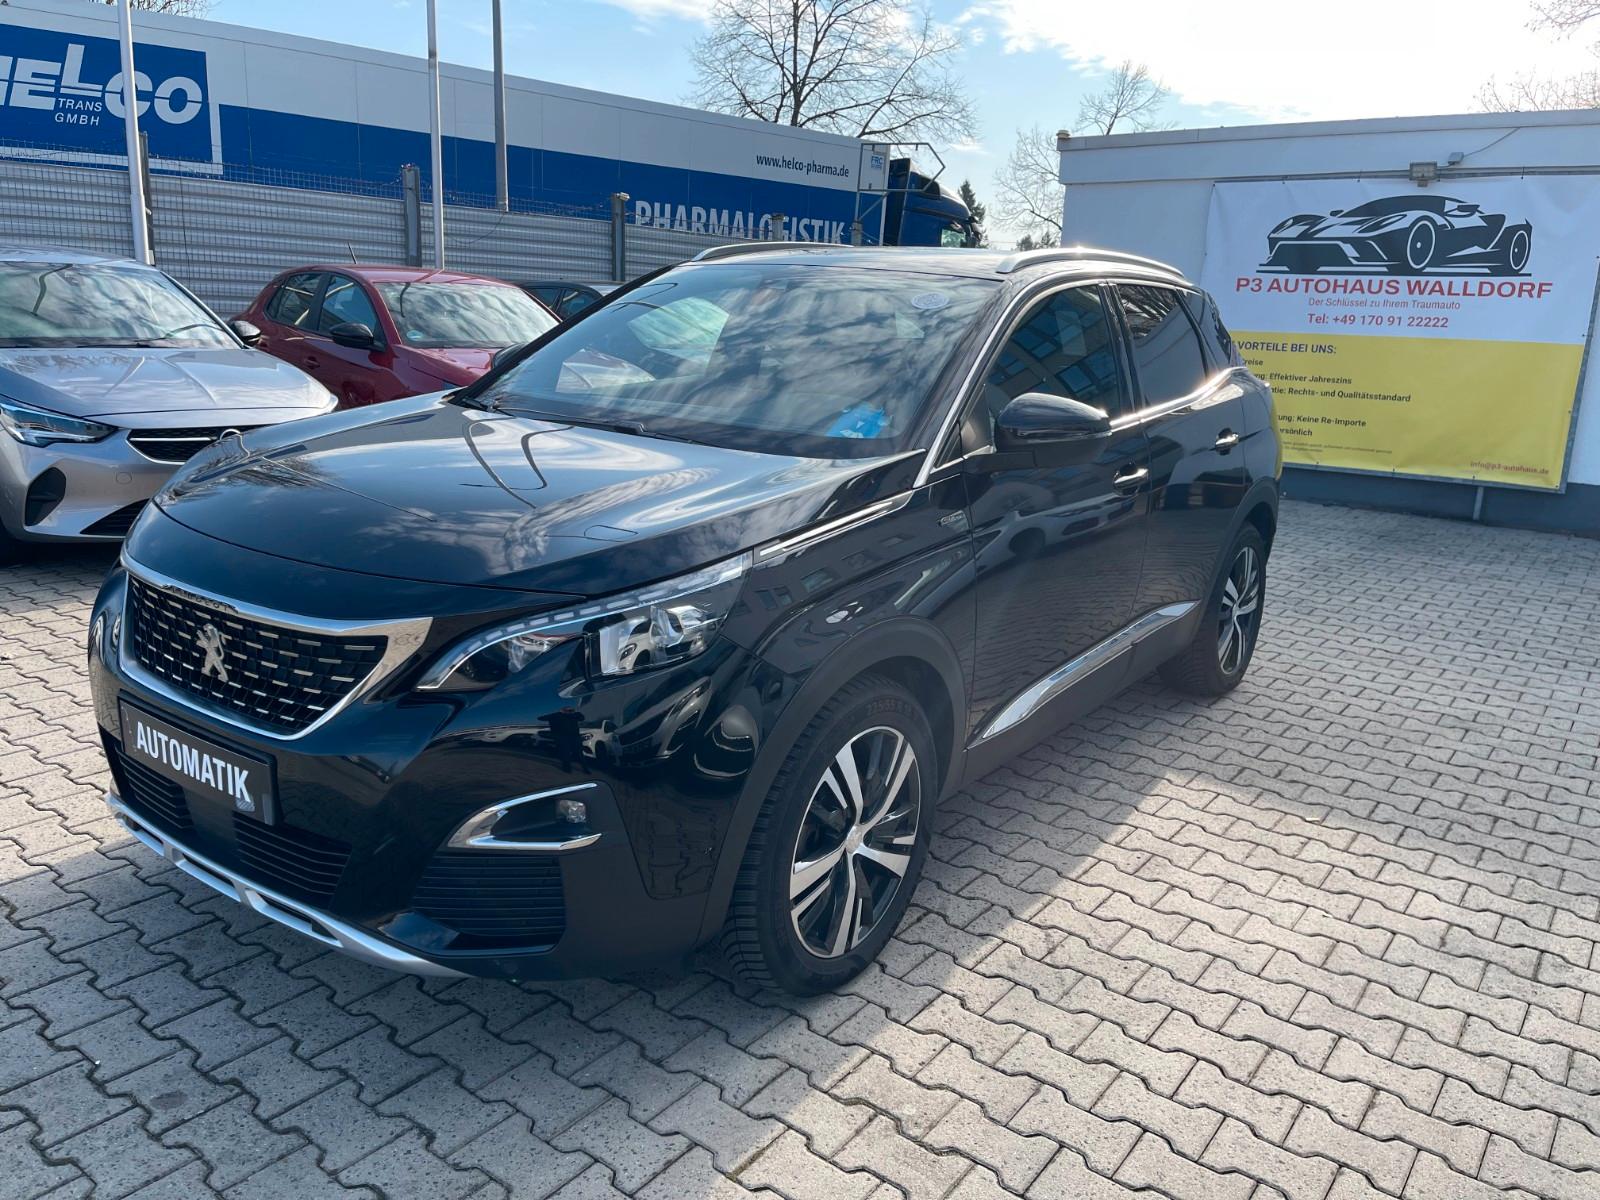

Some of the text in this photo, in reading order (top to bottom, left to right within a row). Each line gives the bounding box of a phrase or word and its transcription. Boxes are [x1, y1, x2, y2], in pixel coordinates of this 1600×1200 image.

[58, 98, 103, 112] TRANS
[55, 112, 100, 126] GMBH
[756, 154, 850, 177] www.helco-pharma.de
[1236, 278, 1553, 299] P3 AUTOHAUS WALLDORF
[1308, 297, 1461, 310] Der Schlüssel zu Ihrem Traumauto
[1307, 313, 1449, 328] Tel: +49 170 91 22222
[1237, 341, 1337, 354] VORTEILE BEI UNS:
[1242, 358, 1264, 366] reise
[1269, 372, 1307, 382] Effektiver
[1308, 375, 1352, 385] Jahreszins
[1288, 387, 1319, 397] Rechts-
[1320, 389, 1336, 398] und
[1337, 390, 1411, 402] Qualitätsstandard
[1296, 415, 1320, 424] Keine
[136, 720, 252, 803] AUTOMATIK
